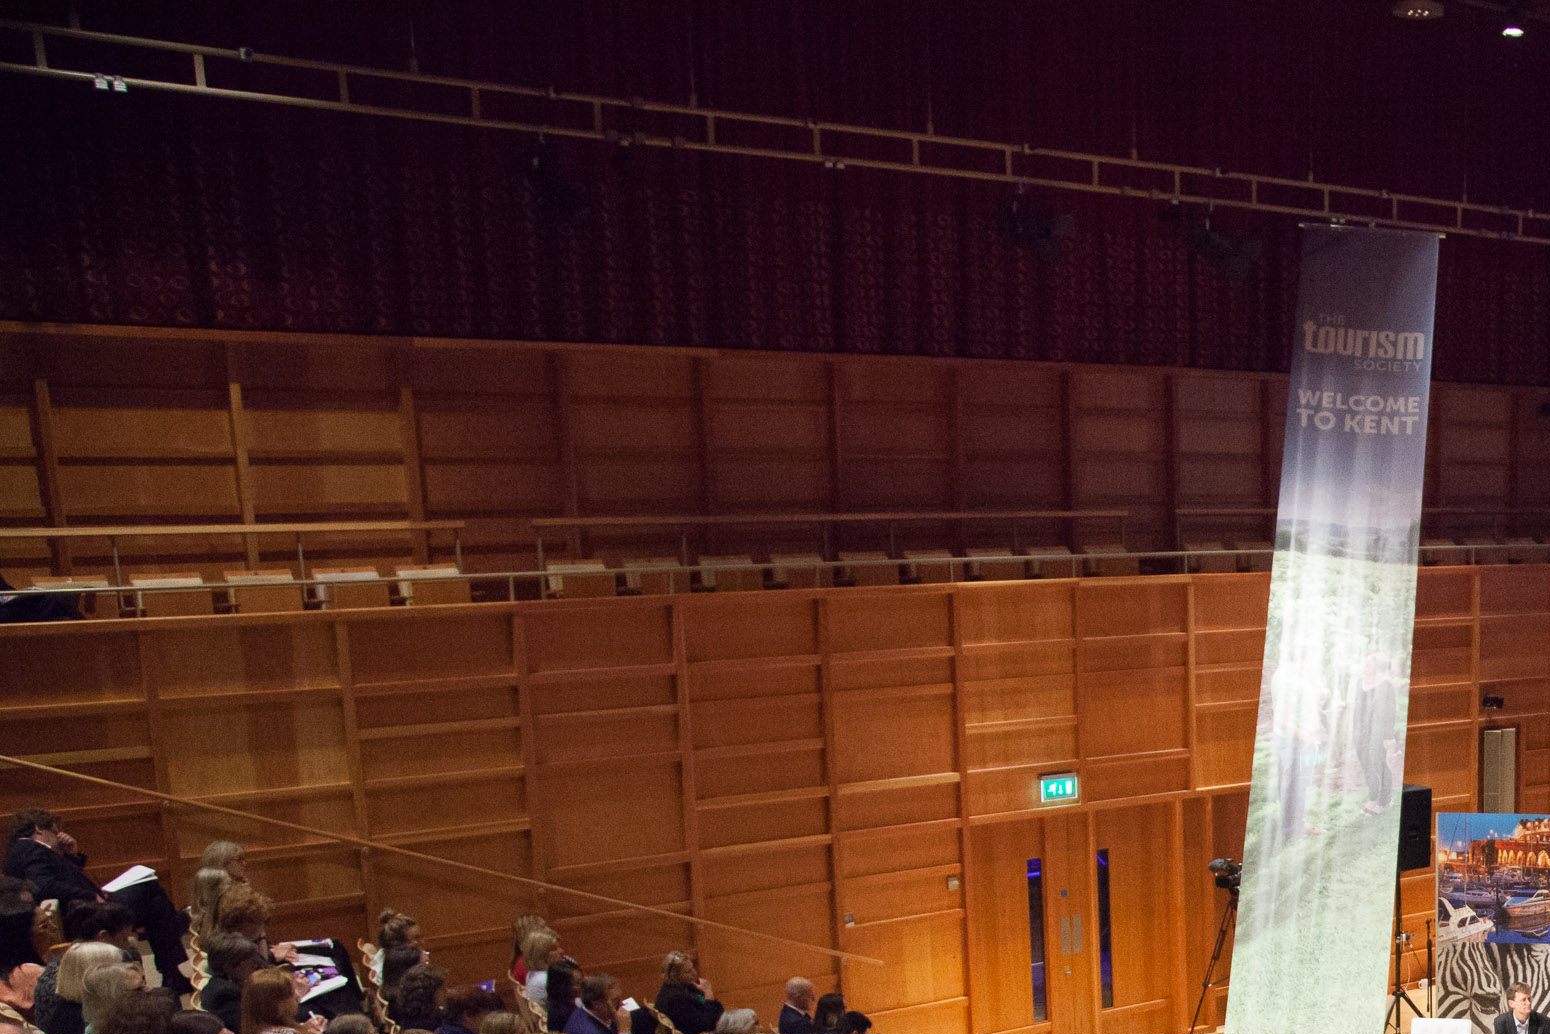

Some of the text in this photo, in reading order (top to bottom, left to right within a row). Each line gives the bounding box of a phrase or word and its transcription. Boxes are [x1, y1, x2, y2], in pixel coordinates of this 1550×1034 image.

[1353, 359, 1423, 372] SOCIETY
[1297, 388, 1420, 414] WELCOME
[1296, 408, 1419, 435] TO KENT
